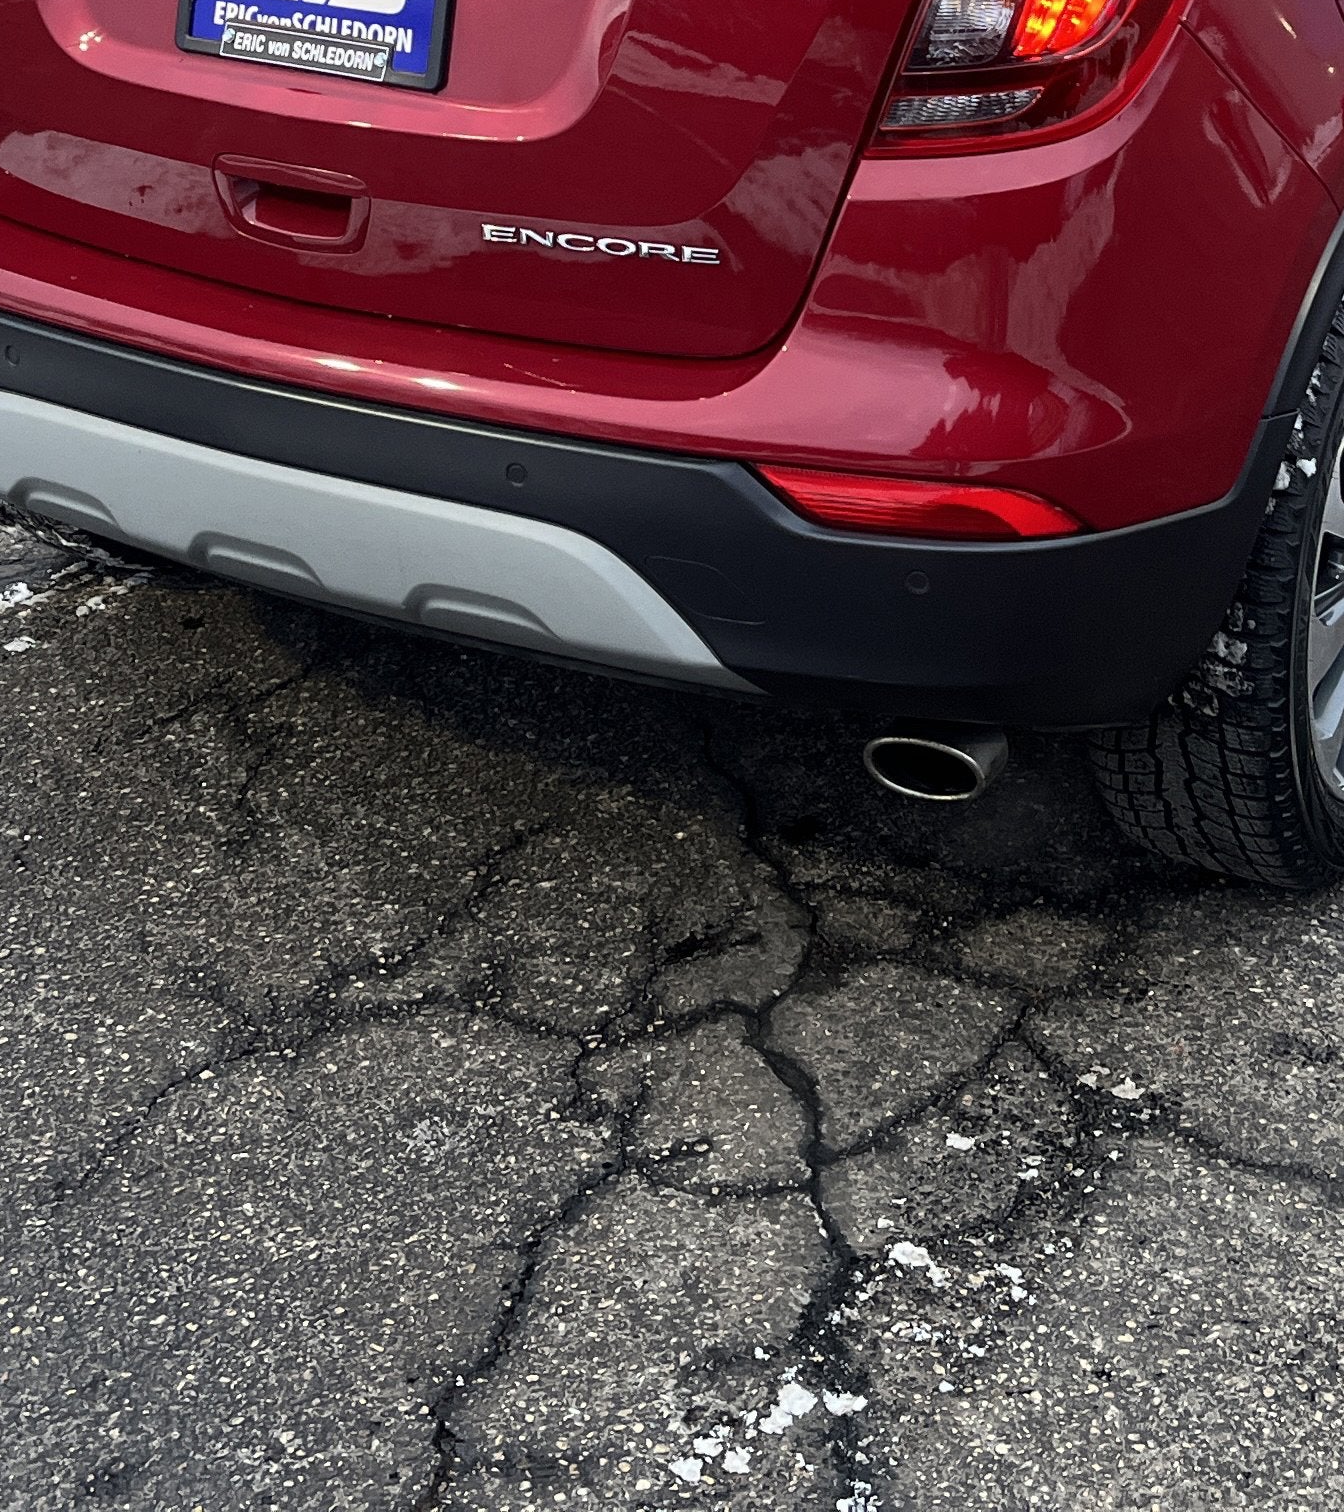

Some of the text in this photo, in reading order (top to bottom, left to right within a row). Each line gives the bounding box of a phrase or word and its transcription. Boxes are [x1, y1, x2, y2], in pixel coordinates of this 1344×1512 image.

[233, 32, 375, 71] ERIC von SCHLEDORN
[481, 223, 720, 264] ENCORE
